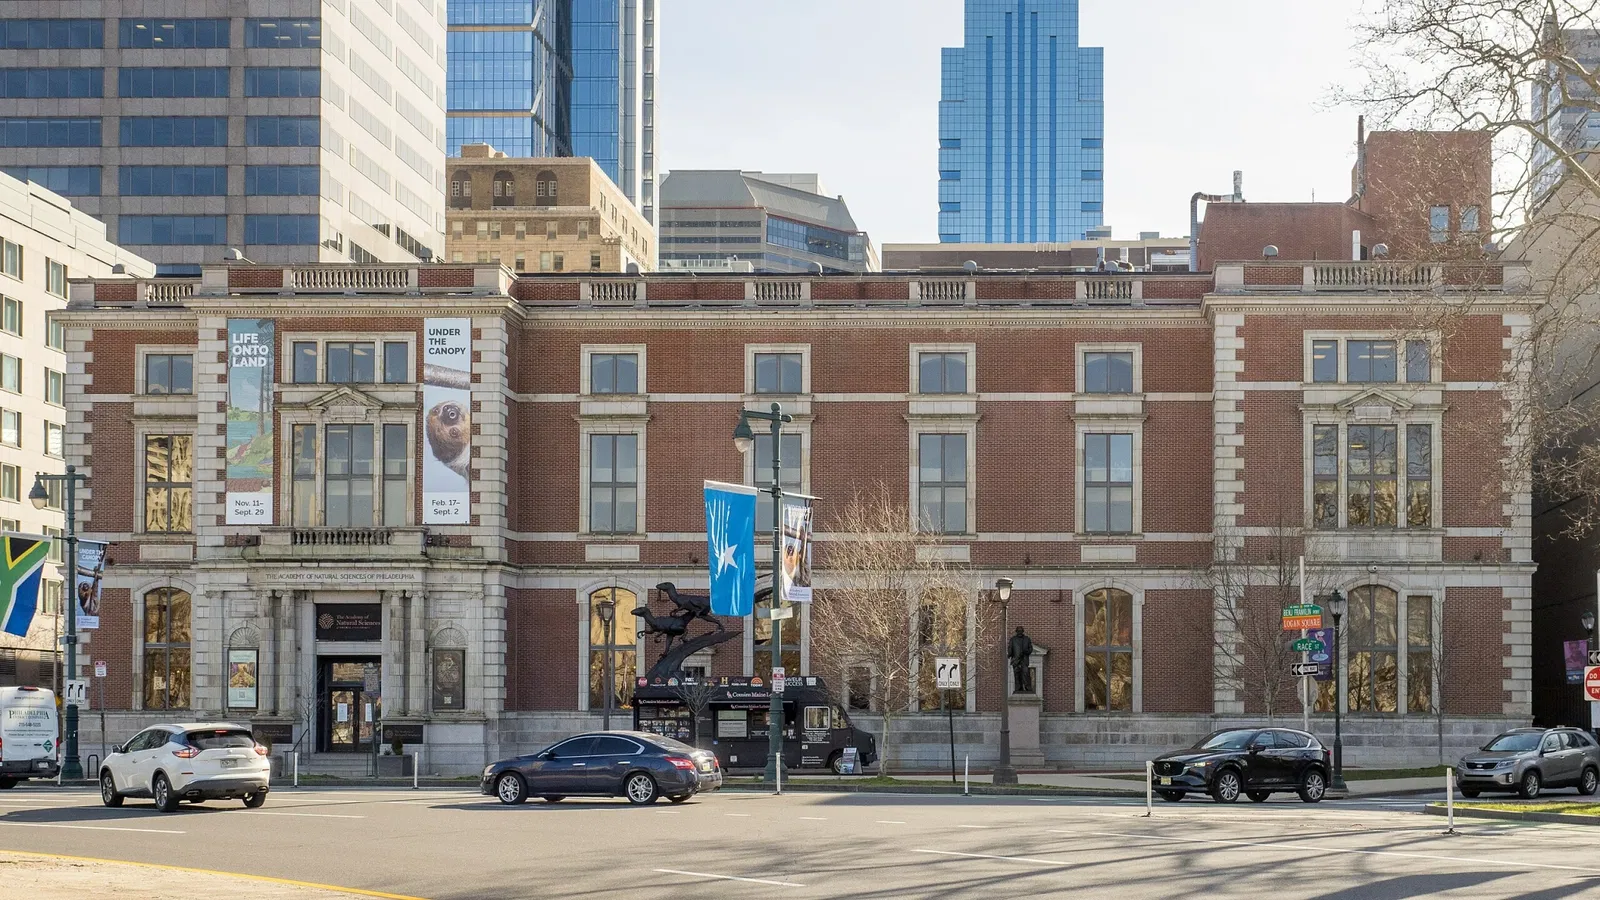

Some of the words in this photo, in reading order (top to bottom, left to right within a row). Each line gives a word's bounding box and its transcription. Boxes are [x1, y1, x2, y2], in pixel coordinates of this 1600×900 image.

[233, 333, 258, 343] LIFE
[232, 345, 269, 355] ONTO
[233, 357, 267, 367] LAND
[1283, 620, 1300, 628] LOGAN
[1301, 619, 1321, 628] SQUARE
[721, 677, 728, 685] H
[8, 710, 50, 719] PHILADELPHIA
